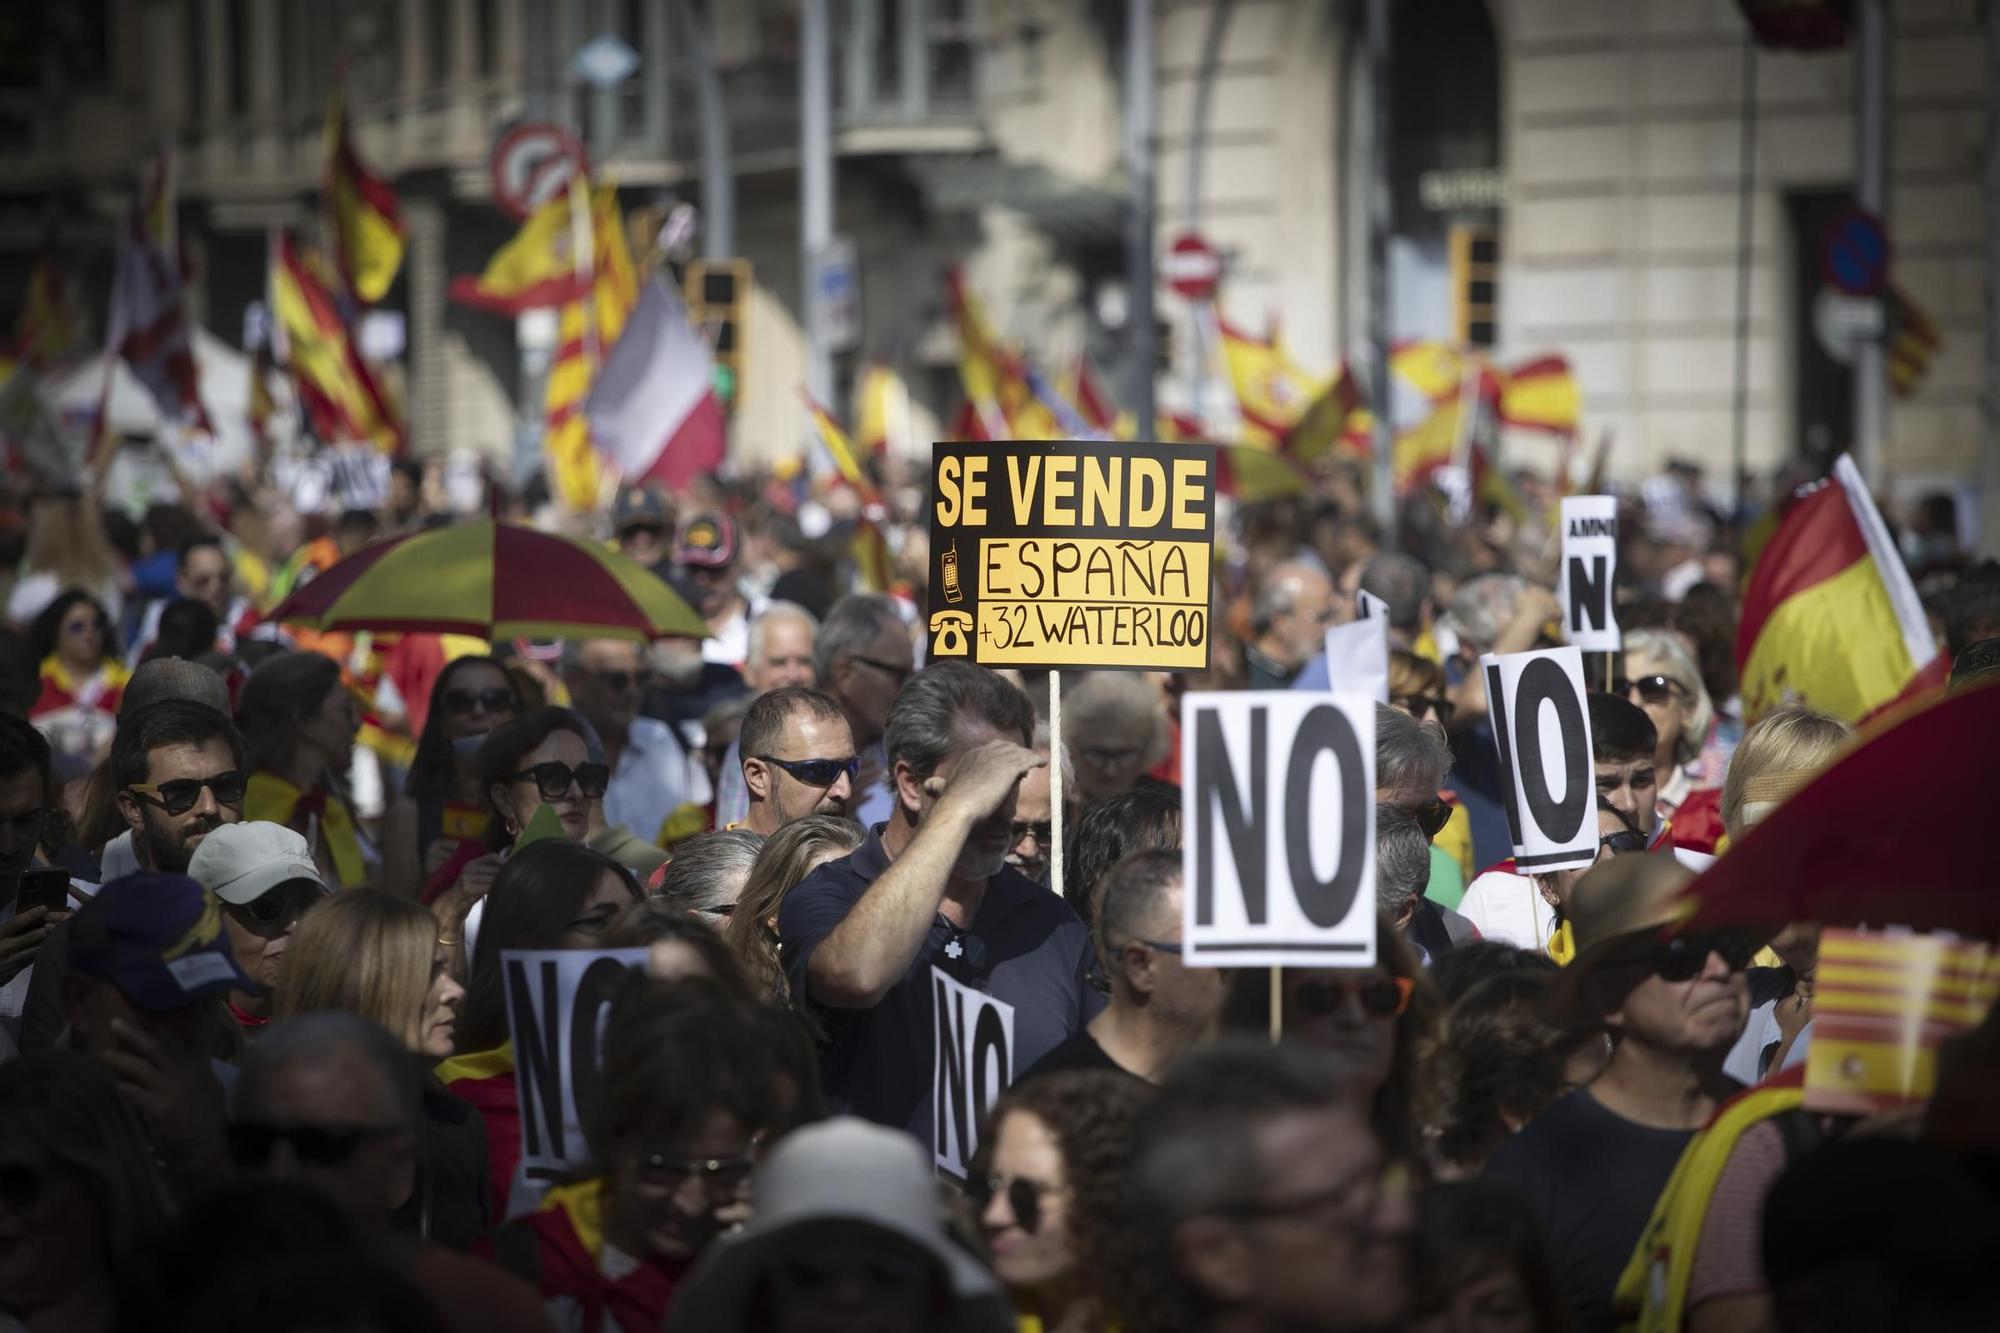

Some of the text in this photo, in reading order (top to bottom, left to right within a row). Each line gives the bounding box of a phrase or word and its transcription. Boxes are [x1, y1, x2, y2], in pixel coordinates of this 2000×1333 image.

[936, 456, 1207, 530] SE VENDE
[987, 540, 1190, 598] ESPAÑA
[1569, 556, 1606, 631] N
[1195, 704, 1367, 928] NO
[936, 976, 1008, 1172] NO
